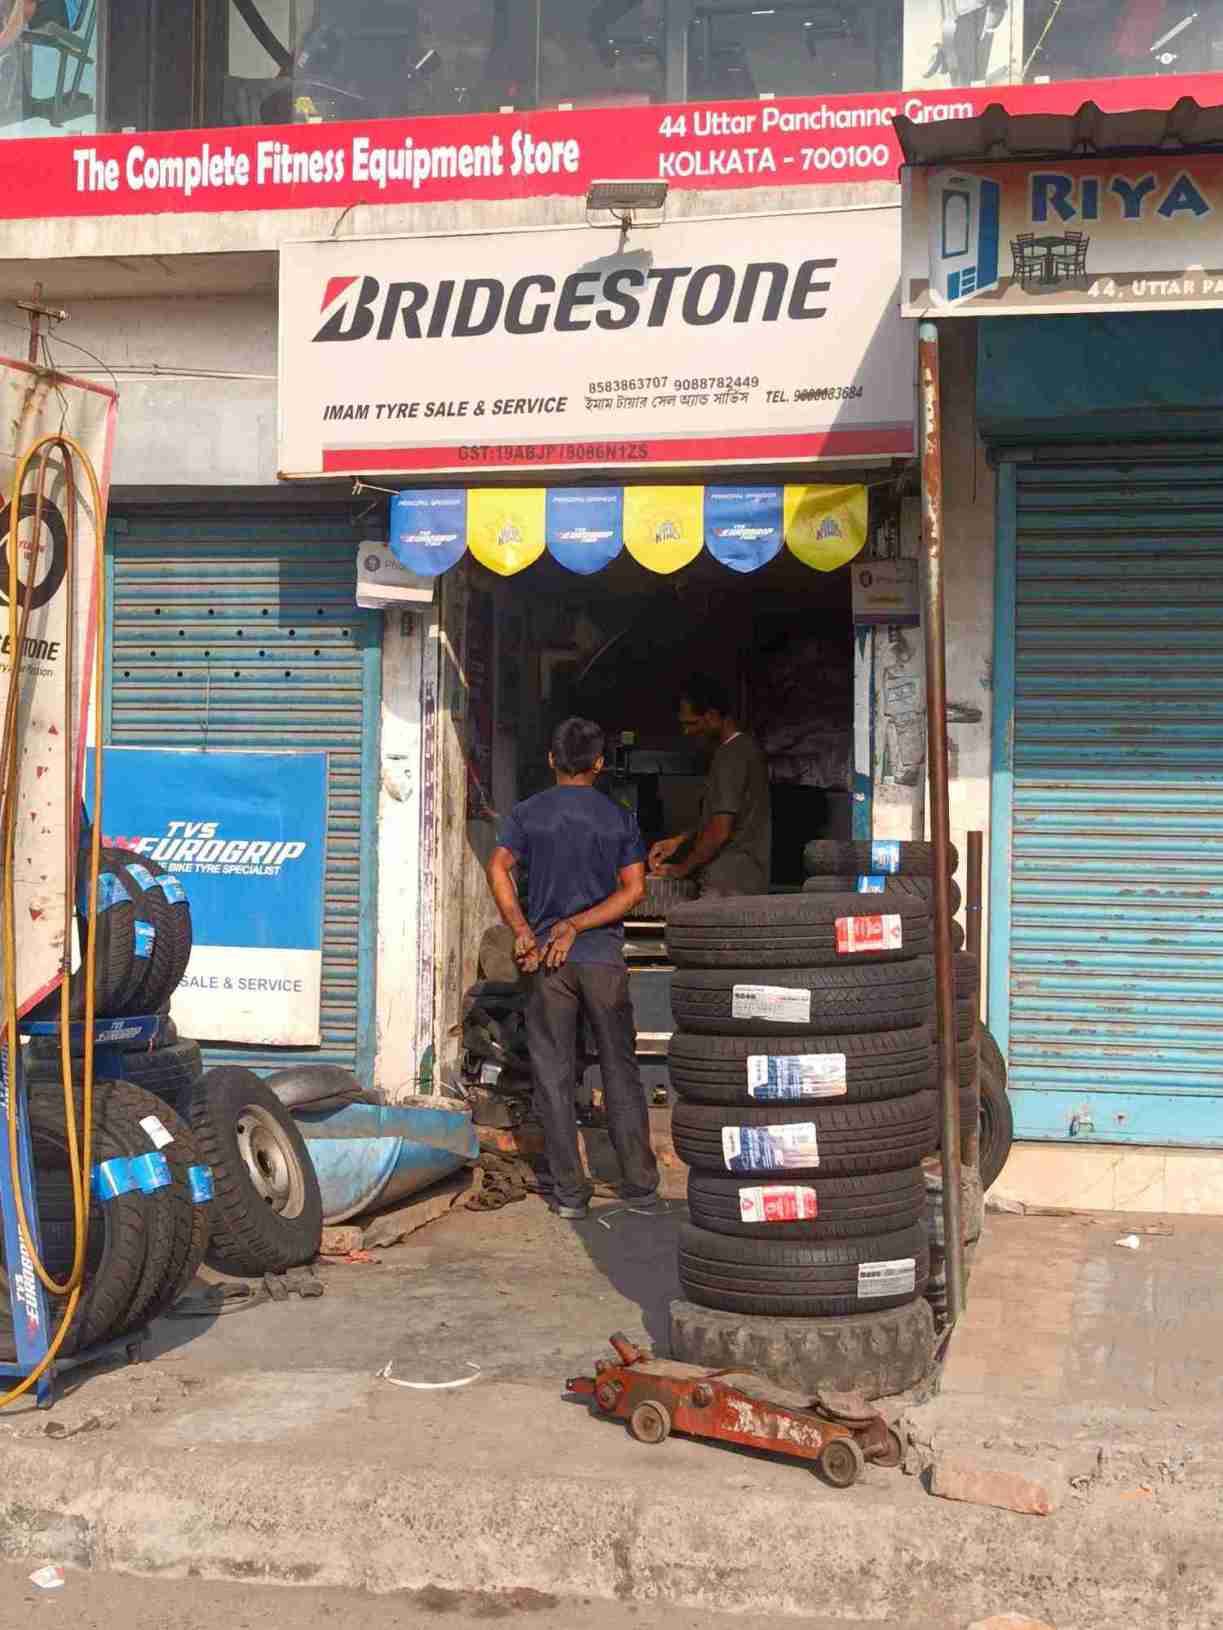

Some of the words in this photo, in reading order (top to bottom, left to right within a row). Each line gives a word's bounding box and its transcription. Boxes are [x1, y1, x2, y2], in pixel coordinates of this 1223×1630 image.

[658, 115, 686, 137] 44
[693, 111, 756, 136] Uttar
[904, 99, 973, 124] Gram
[73, 149, 118, 191] The
[125, 142, 249, 195] Complete
[256, 138, 345, 185] Fitness
[352, 136, 504, 187] Equipment
[511, 130, 580, 177] Store
[658, 148, 776, 177] KOLKATA
[801, 144, 889, 170] 700100
[1030, 171, 1212, 222] RIYA
[1132, 279, 1195, 296] UTTAR
[311, 258, 837, 343] BRIDGESTONE
[589, 376, 668, 393] 8583863707
[674, 376, 759, 391] 9088782449
[323, 404, 369, 421] IMAM
[375, 402, 420, 420] TYRE
[424, 400, 469, 418] SALE
[473, 400, 485, 416] &
[492, 397, 568, 416] SERVICE
[766, 391, 789, 403] TEL.
[167, 821, 219, 839] TVS
[133, 837, 306, 865] EUROGRIP
[168, 863, 192, 873] BIKE
[195, 863, 220, 873] TYRE
[222, 864, 281, 876] SPECIALIST
[179, 976, 218, 989] SALE
[223, 977, 233, 990] &
[238, 977, 303, 993] SERVICE
